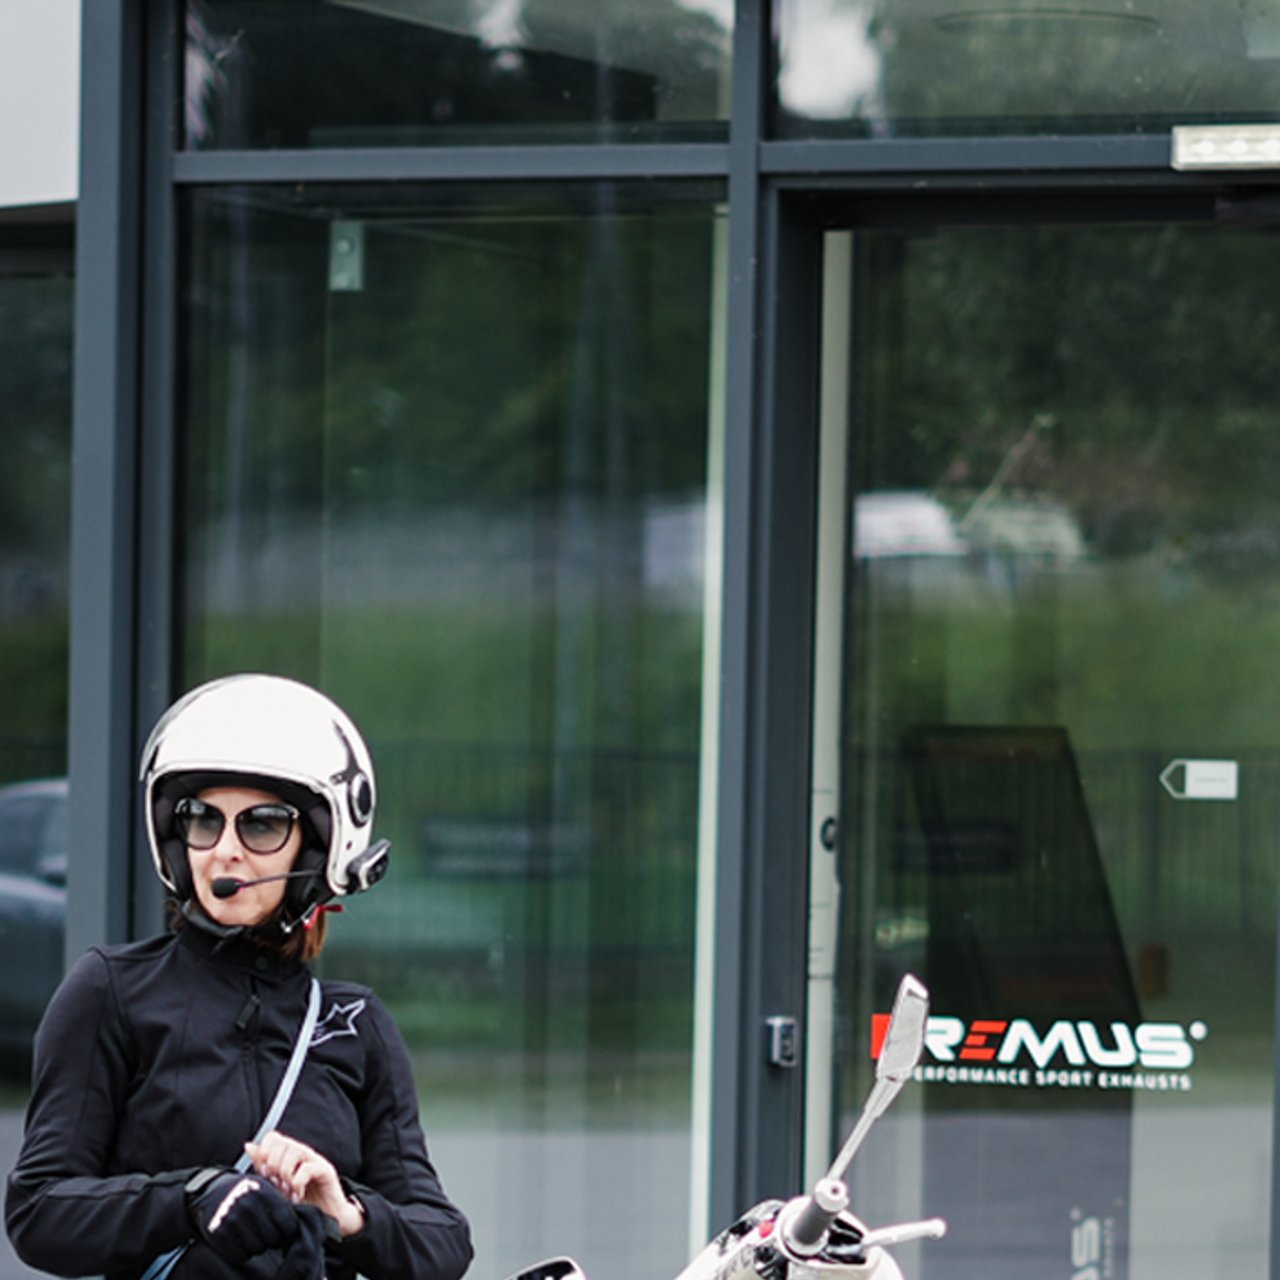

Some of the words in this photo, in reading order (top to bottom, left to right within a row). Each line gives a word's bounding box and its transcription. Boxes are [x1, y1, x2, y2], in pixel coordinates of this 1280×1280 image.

[913, 1065, 1029, 1086] ERFORMANCE
[1035, 1068, 1092, 1088] SPORT
[1098, 1070, 1192, 1091] EXHAUSTS
